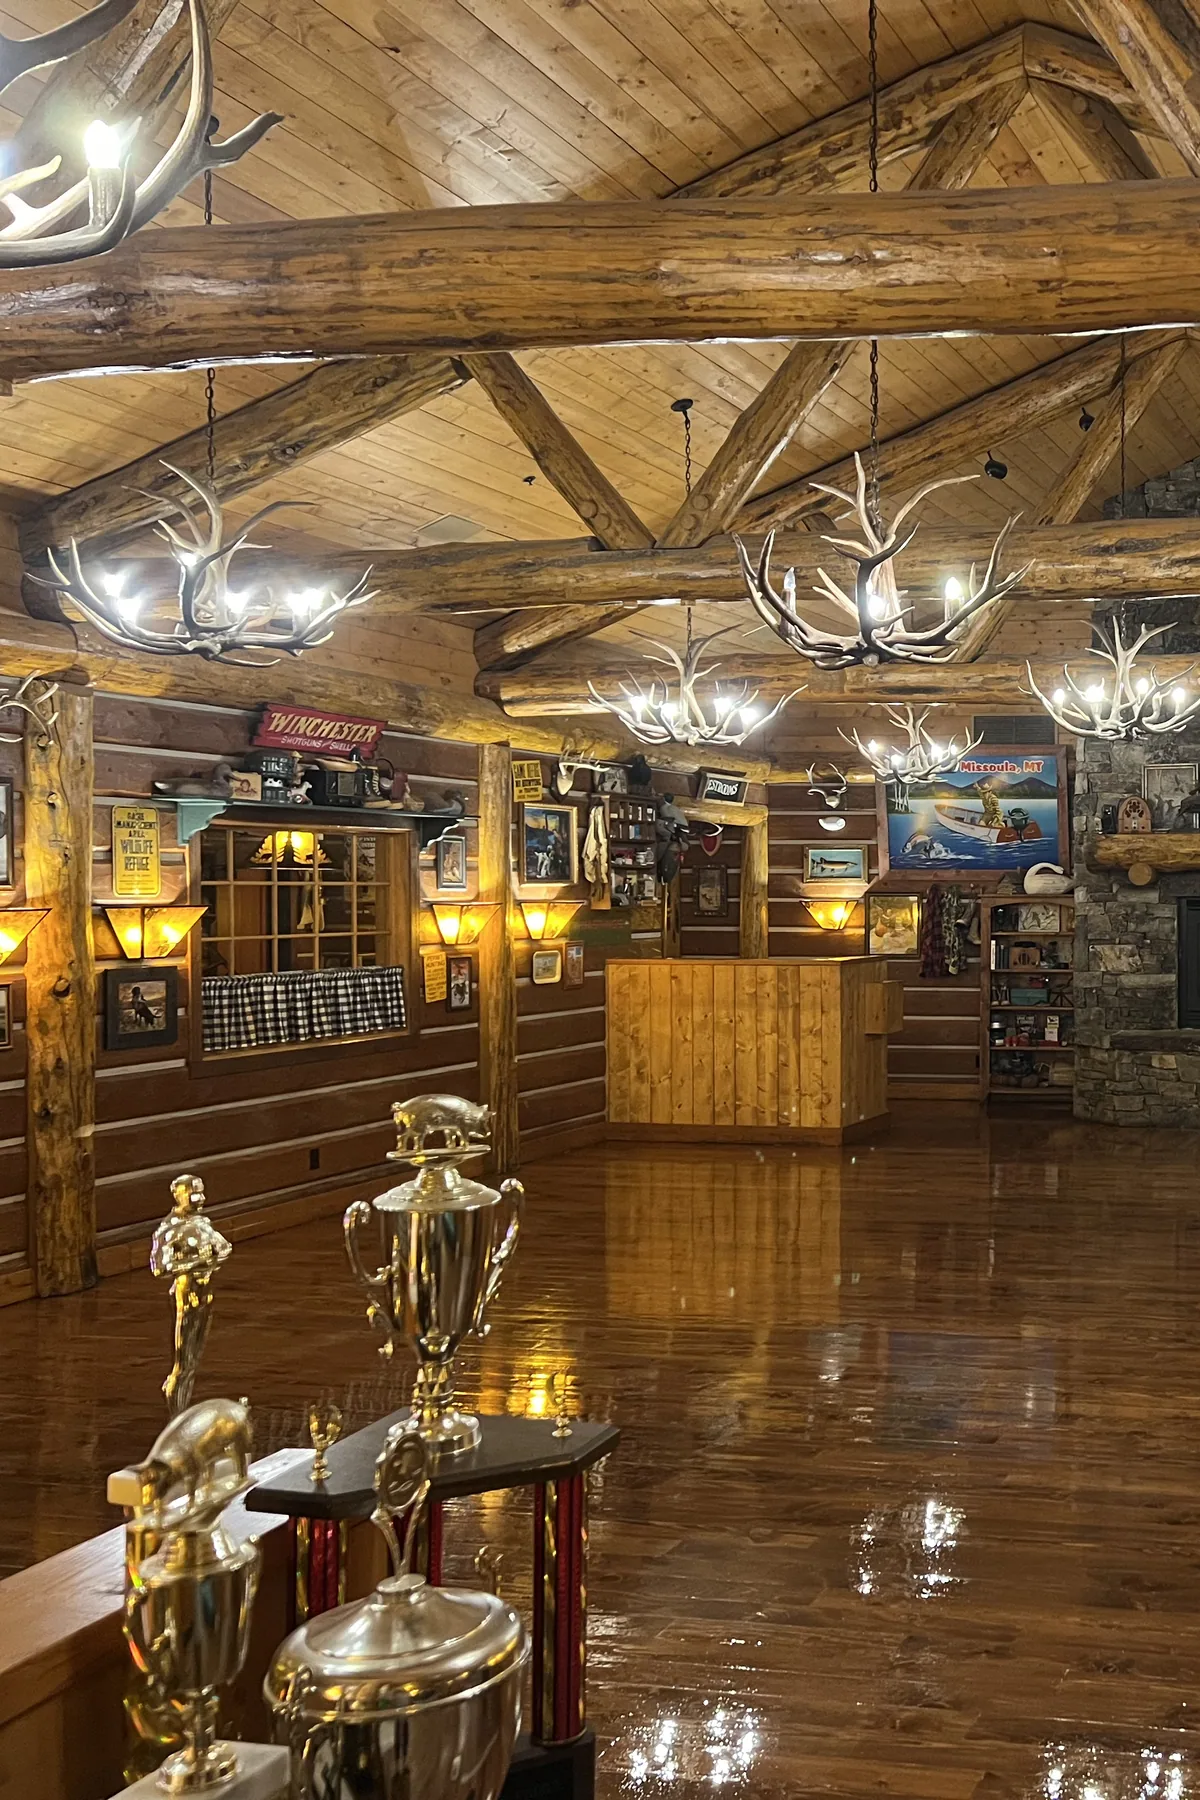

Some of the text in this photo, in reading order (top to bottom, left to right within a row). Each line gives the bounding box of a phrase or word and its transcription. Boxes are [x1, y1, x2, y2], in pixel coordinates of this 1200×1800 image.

[267, 712, 378, 743] WINCHESTER
[281, 735, 323, 749] SHOTGUNS
[960, 760, 1043, 774] Missoula, MT
[120, 839, 154, 855] WILDLIFE
[124, 856, 150, 871] REFUGE
